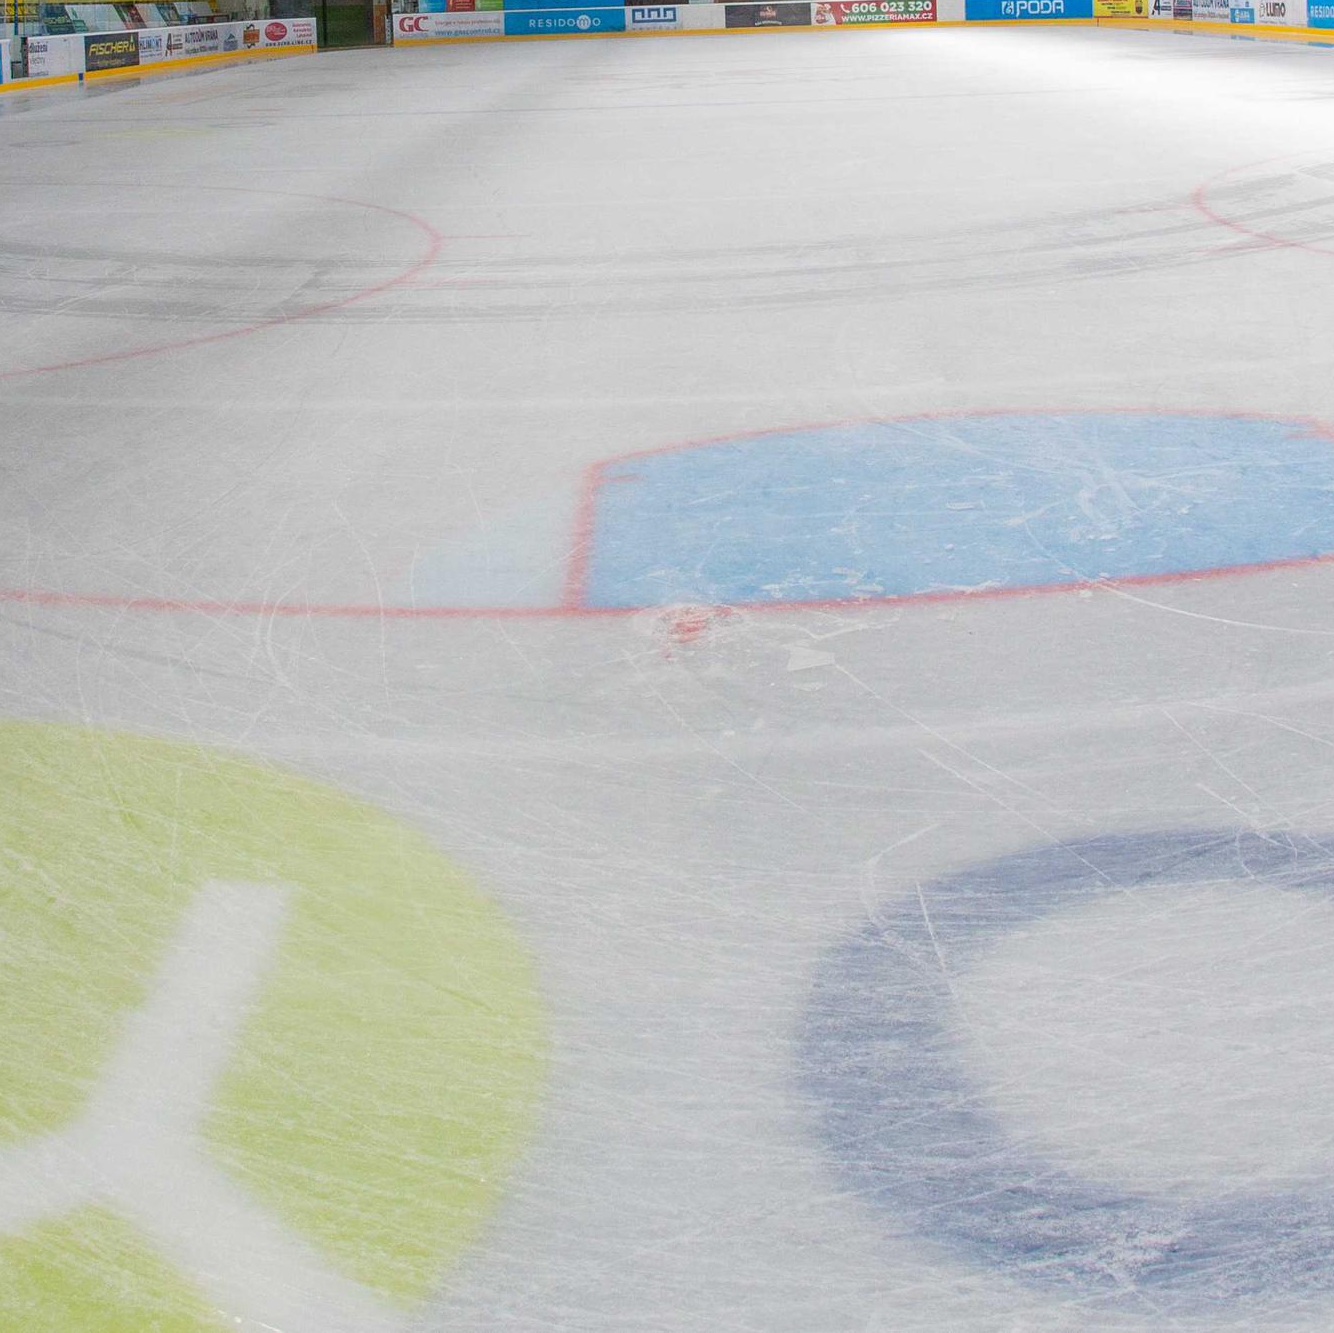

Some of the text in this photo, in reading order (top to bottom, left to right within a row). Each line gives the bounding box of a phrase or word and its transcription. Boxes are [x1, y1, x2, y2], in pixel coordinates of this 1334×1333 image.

[852, 0, 933, 13] 606 023 320
[1016, 0, 1064, 18] PODA
[1266, 2, 1286, 17] LUMO
[399, 16, 428, 33] GC
[529, 14, 601, 30] RESIDOMO
[841, 12, 933, 23] WWW.PIZZERIAMAX.CZ
[89, 40, 129, 56] FISCHER
